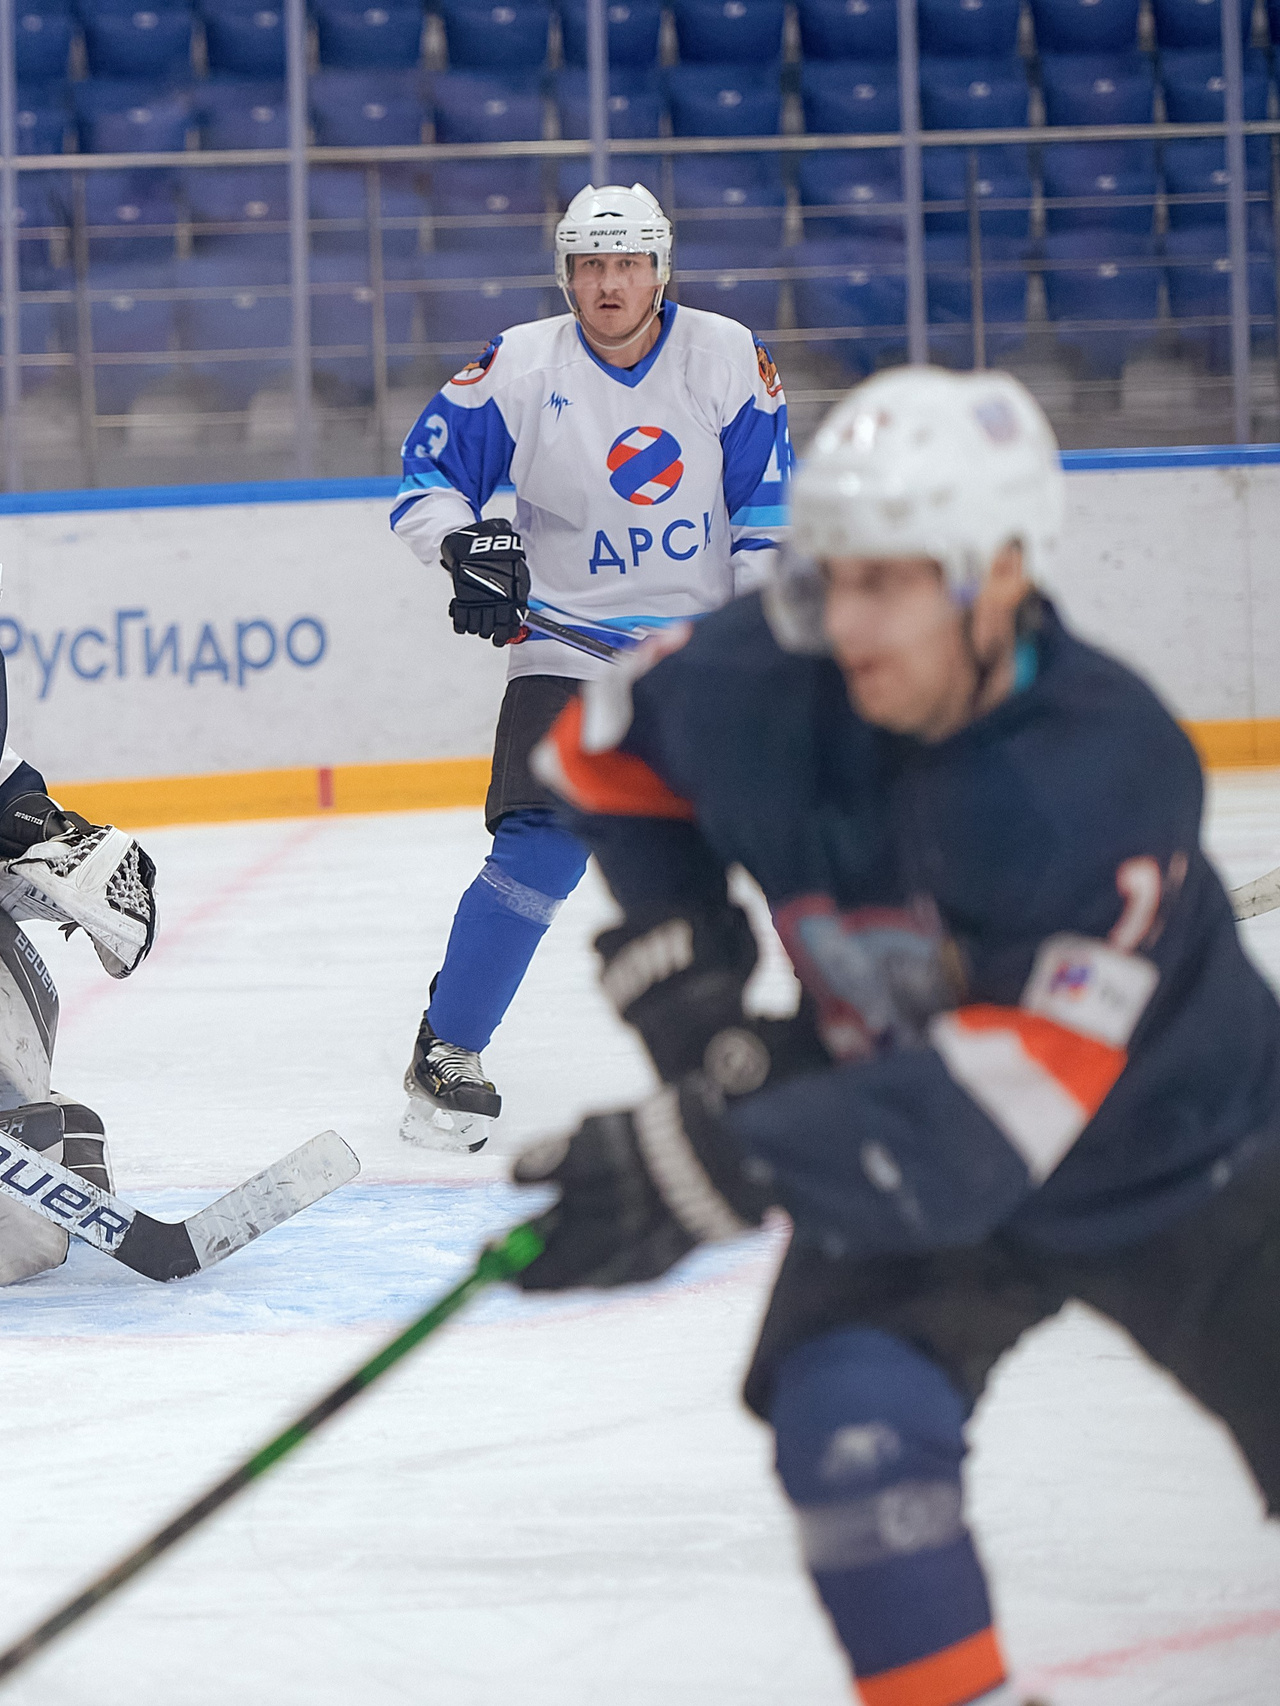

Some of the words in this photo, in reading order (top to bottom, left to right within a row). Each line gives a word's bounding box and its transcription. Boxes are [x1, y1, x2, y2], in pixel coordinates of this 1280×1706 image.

[589, 229, 627, 237] BAUER
[400, 413, 449, 460] 3
[15, 931, 58, 1002] BAUER
